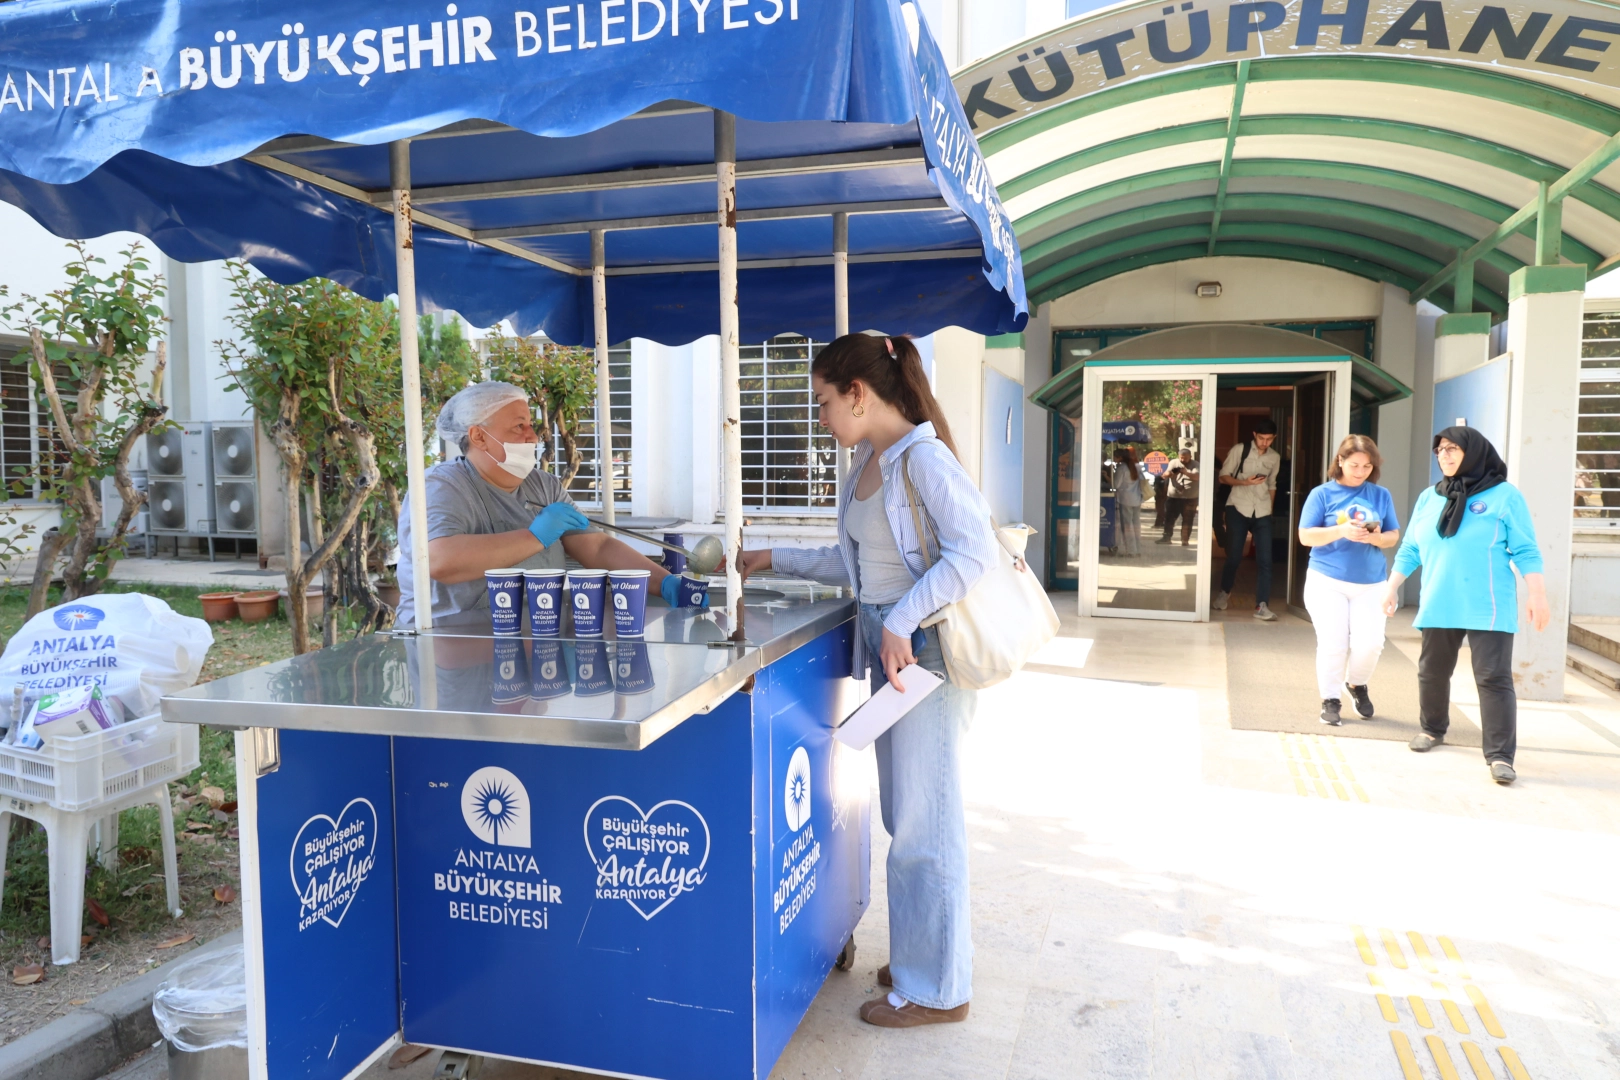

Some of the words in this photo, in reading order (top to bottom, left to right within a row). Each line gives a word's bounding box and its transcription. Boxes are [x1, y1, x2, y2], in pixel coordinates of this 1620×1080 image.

[180, 3, 496, 90] BÜYÜKŞEHİR
[965, 0, 1620, 130] KÜTÜPHANE
[21, 653, 118, 676] BÜYÜKŞEHİR
[28, 635, 116, 656] ANTALYA
[305, 819, 365, 857] Büyükşehir
[602, 817, 690, 839] Büyükşehir
[602, 834, 690, 856] ÇALIŞIYOR
[305, 834, 365, 877] ÇALIŞIYOR
[454, 848, 540, 875] ANTALYA
[782, 823, 814, 874] ANTALYA
[300, 853, 376, 918] Antalya
[434, 869, 562, 904] BÜYÜKŞEHİR
[595, 888, 667, 900] KAZANIYOR
[596, 853, 708, 898] Antalya
[773, 840, 821, 914] BÜYÜKŞEHİR
[298, 889, 350, 932] KAZANIYOR
[449, 901, 549, 930] BELEDİYESİ
[780, 868, 817, 936] BELEDİYESİ
